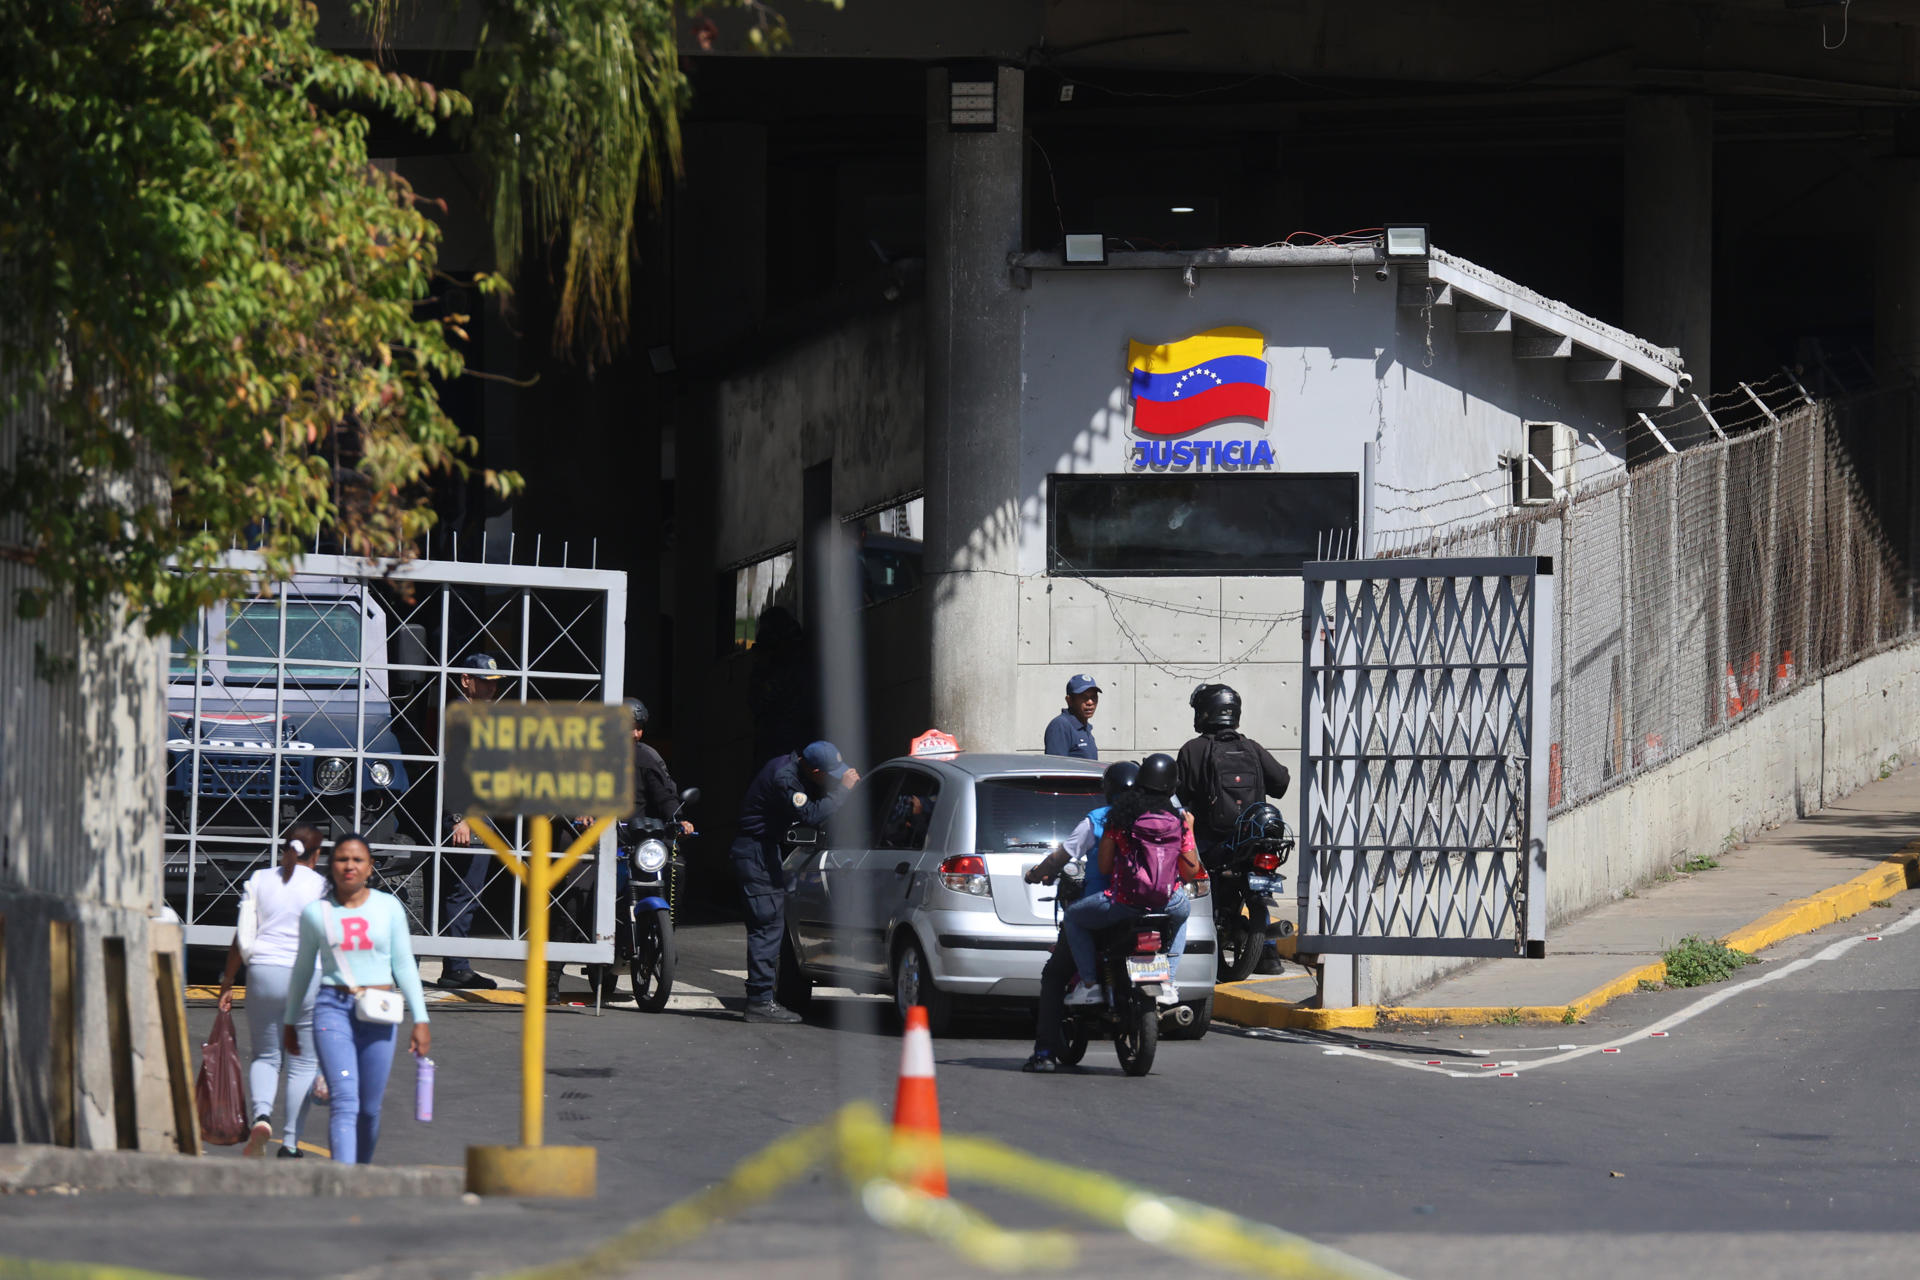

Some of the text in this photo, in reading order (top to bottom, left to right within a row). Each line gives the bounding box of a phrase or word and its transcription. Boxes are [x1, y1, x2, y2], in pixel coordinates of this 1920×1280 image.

[1134, 439, 1274, 467] JUSTICIA
[470, 714, 606, 750] NO PARE
[470, 770, 616, 800] COMANDO
[340, 916, 374, 951] R
